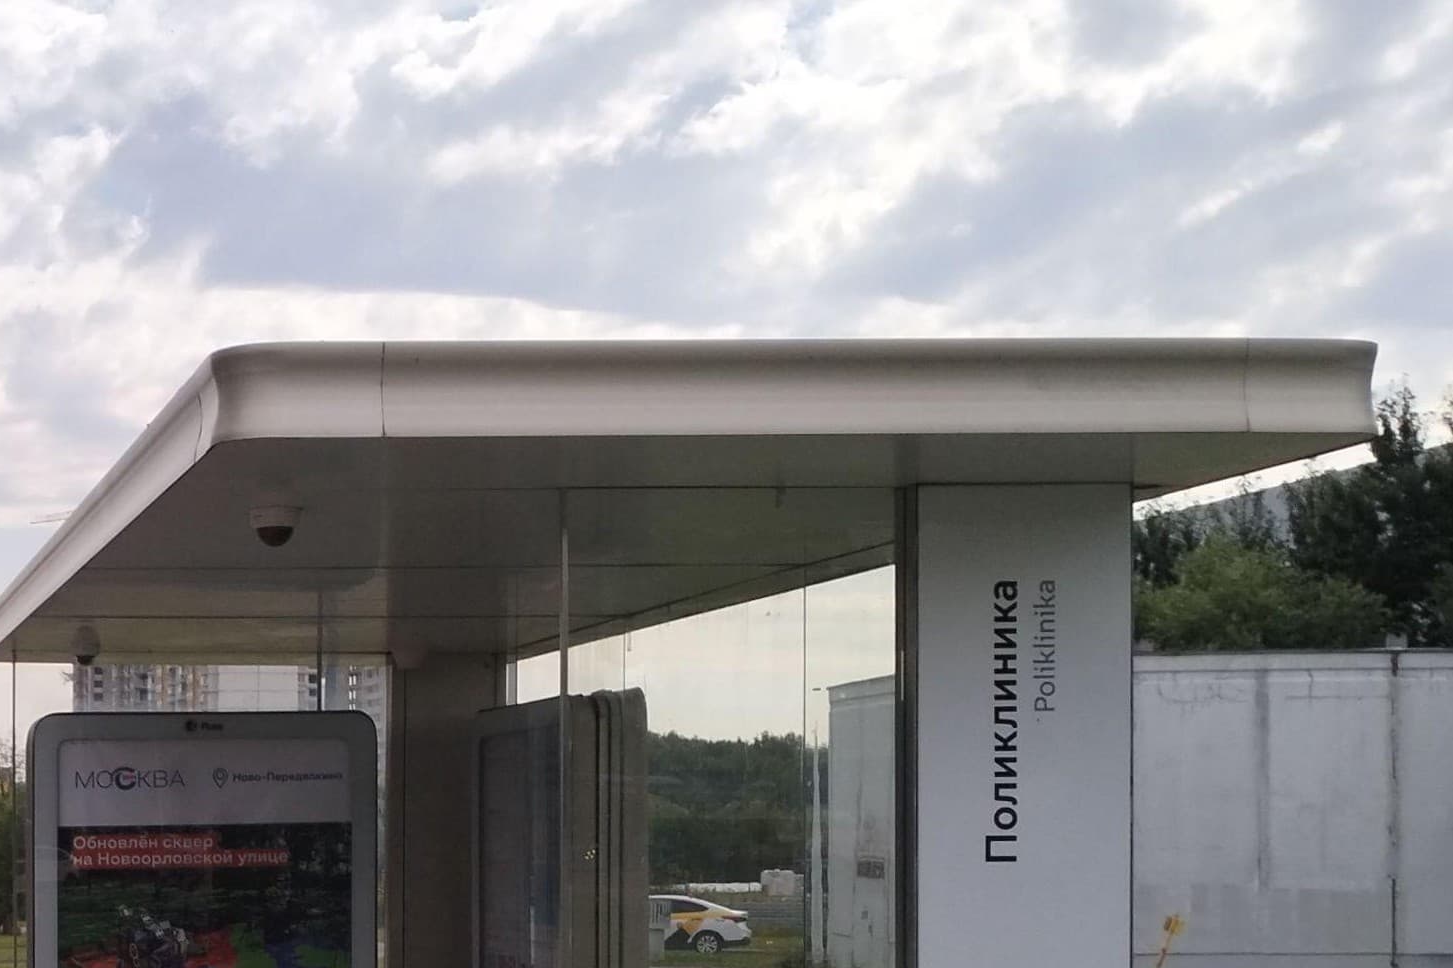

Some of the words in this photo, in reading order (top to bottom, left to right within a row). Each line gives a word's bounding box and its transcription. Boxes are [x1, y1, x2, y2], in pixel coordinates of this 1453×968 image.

[1033, 580, 1055, 711] Poliklinika
[985, 580, 1018, 862] Поликлиника
[75, 767, 186, 790] МОСКВА
[73, 833, 158, 849] Обновлён
[163, 837, 213, 850] сквер
[73, 855, 93, 866] на
[98, 850, 233, 867] Новоорловской
[237, 852, 289, 866] улице
